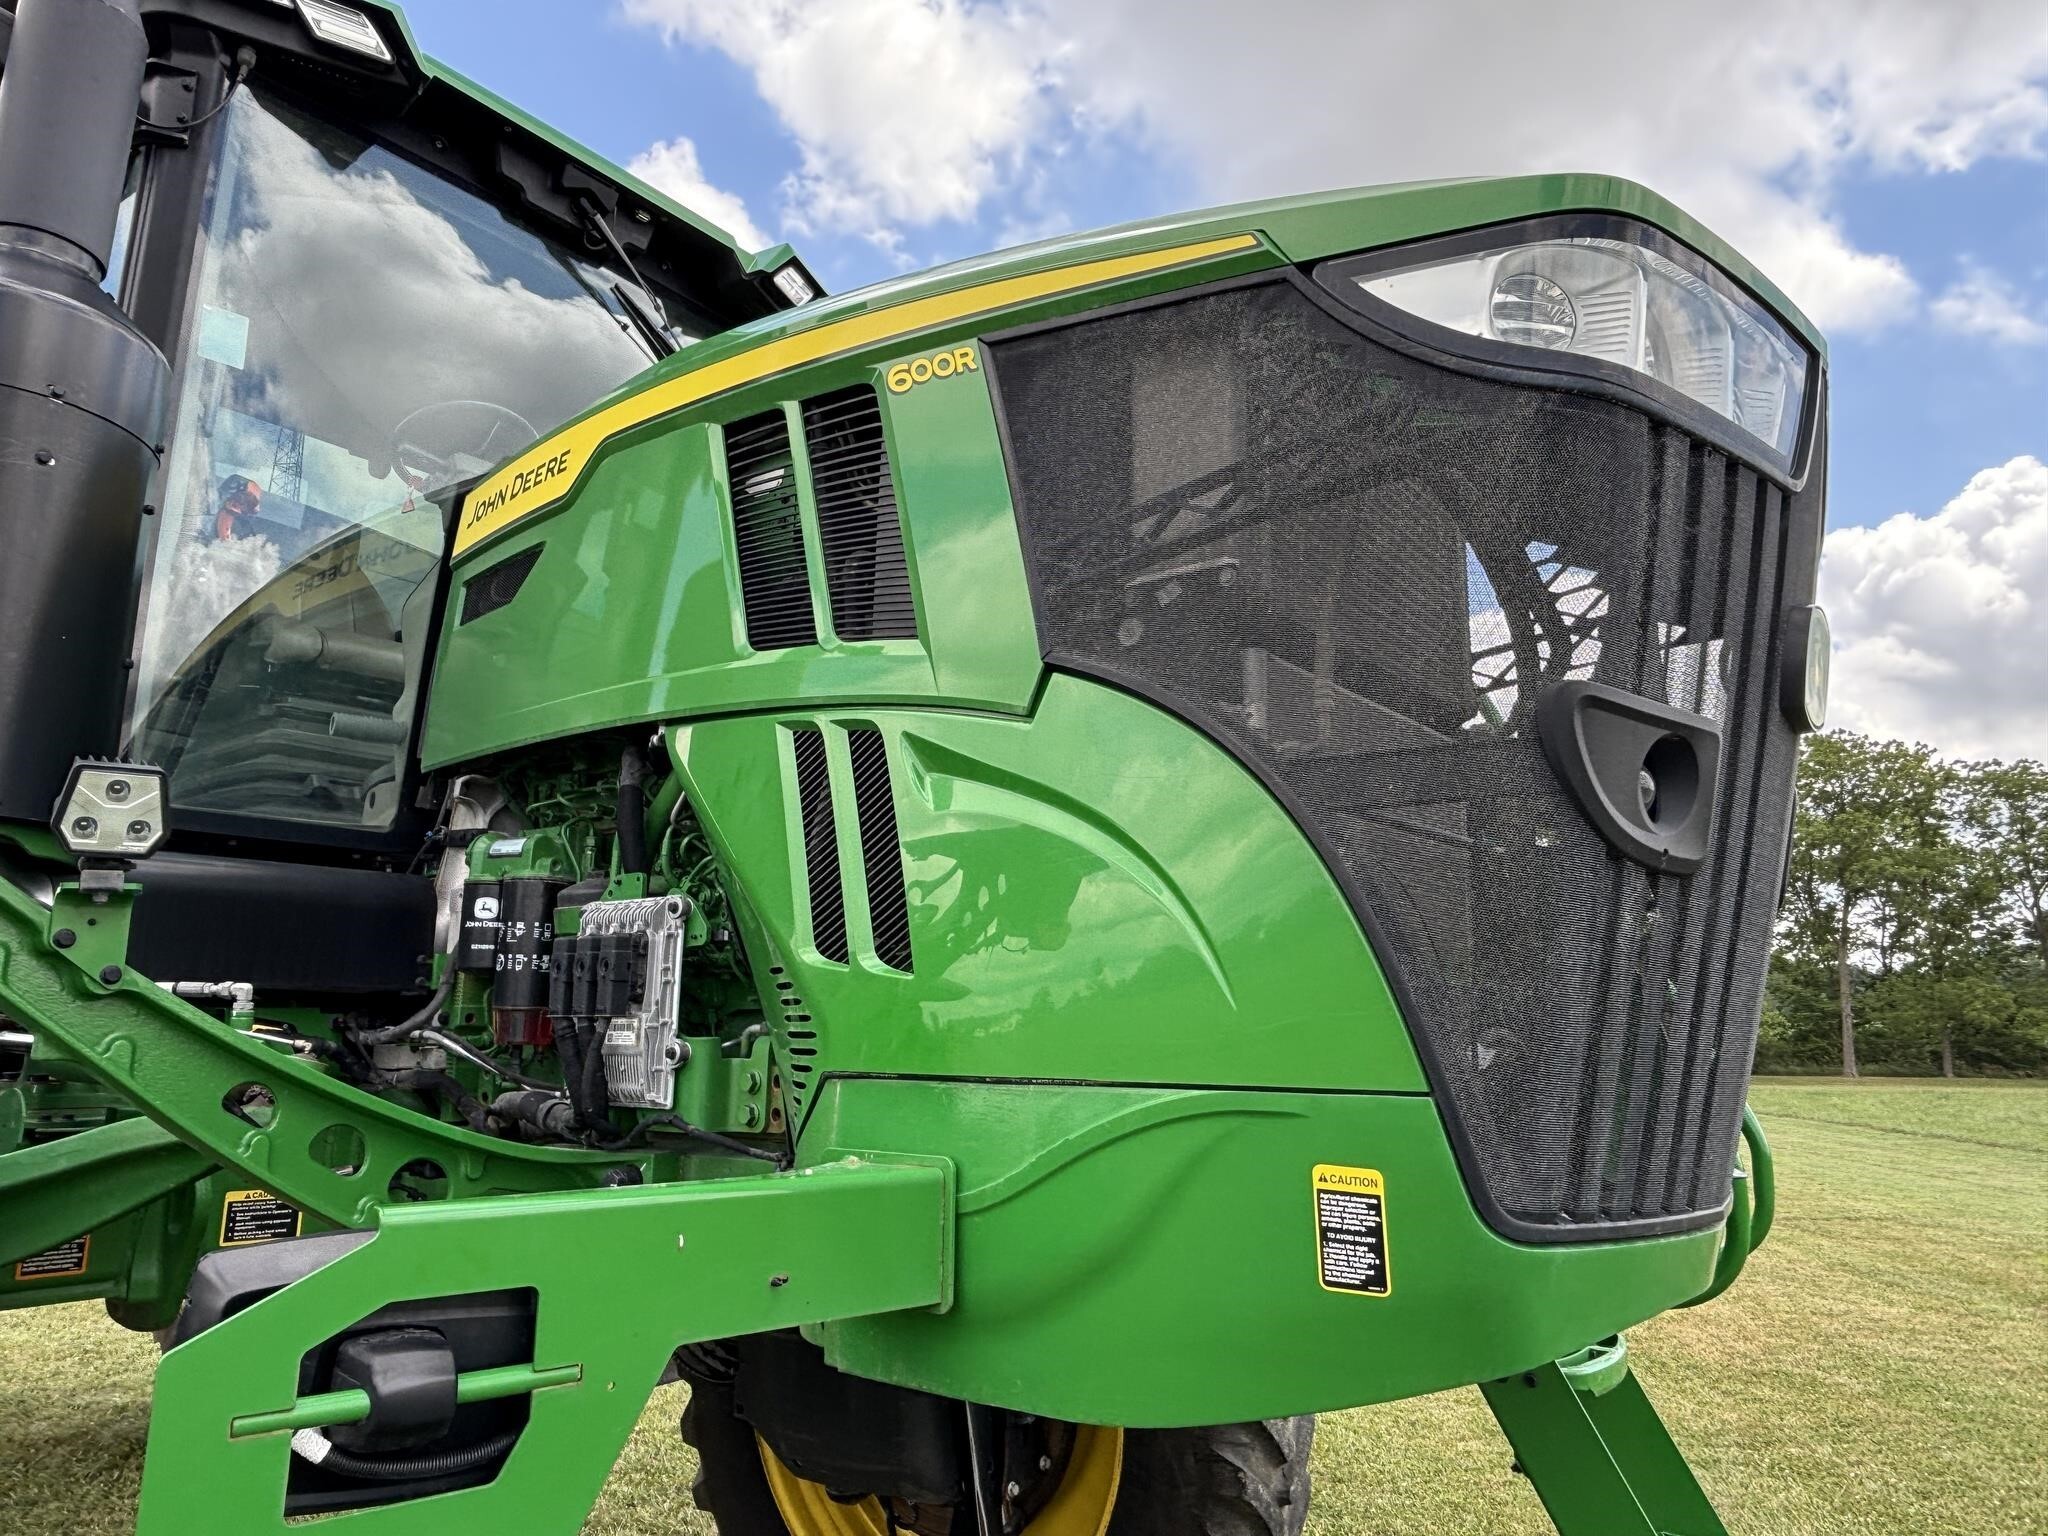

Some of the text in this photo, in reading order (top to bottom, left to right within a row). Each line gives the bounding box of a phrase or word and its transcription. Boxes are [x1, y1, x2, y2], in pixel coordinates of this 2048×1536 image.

[887, 347, 978, 392] 600R
[466, 449, 571, 529] JOHN DEERE
[1329, 1174, 1378, 1188] CAUTION
